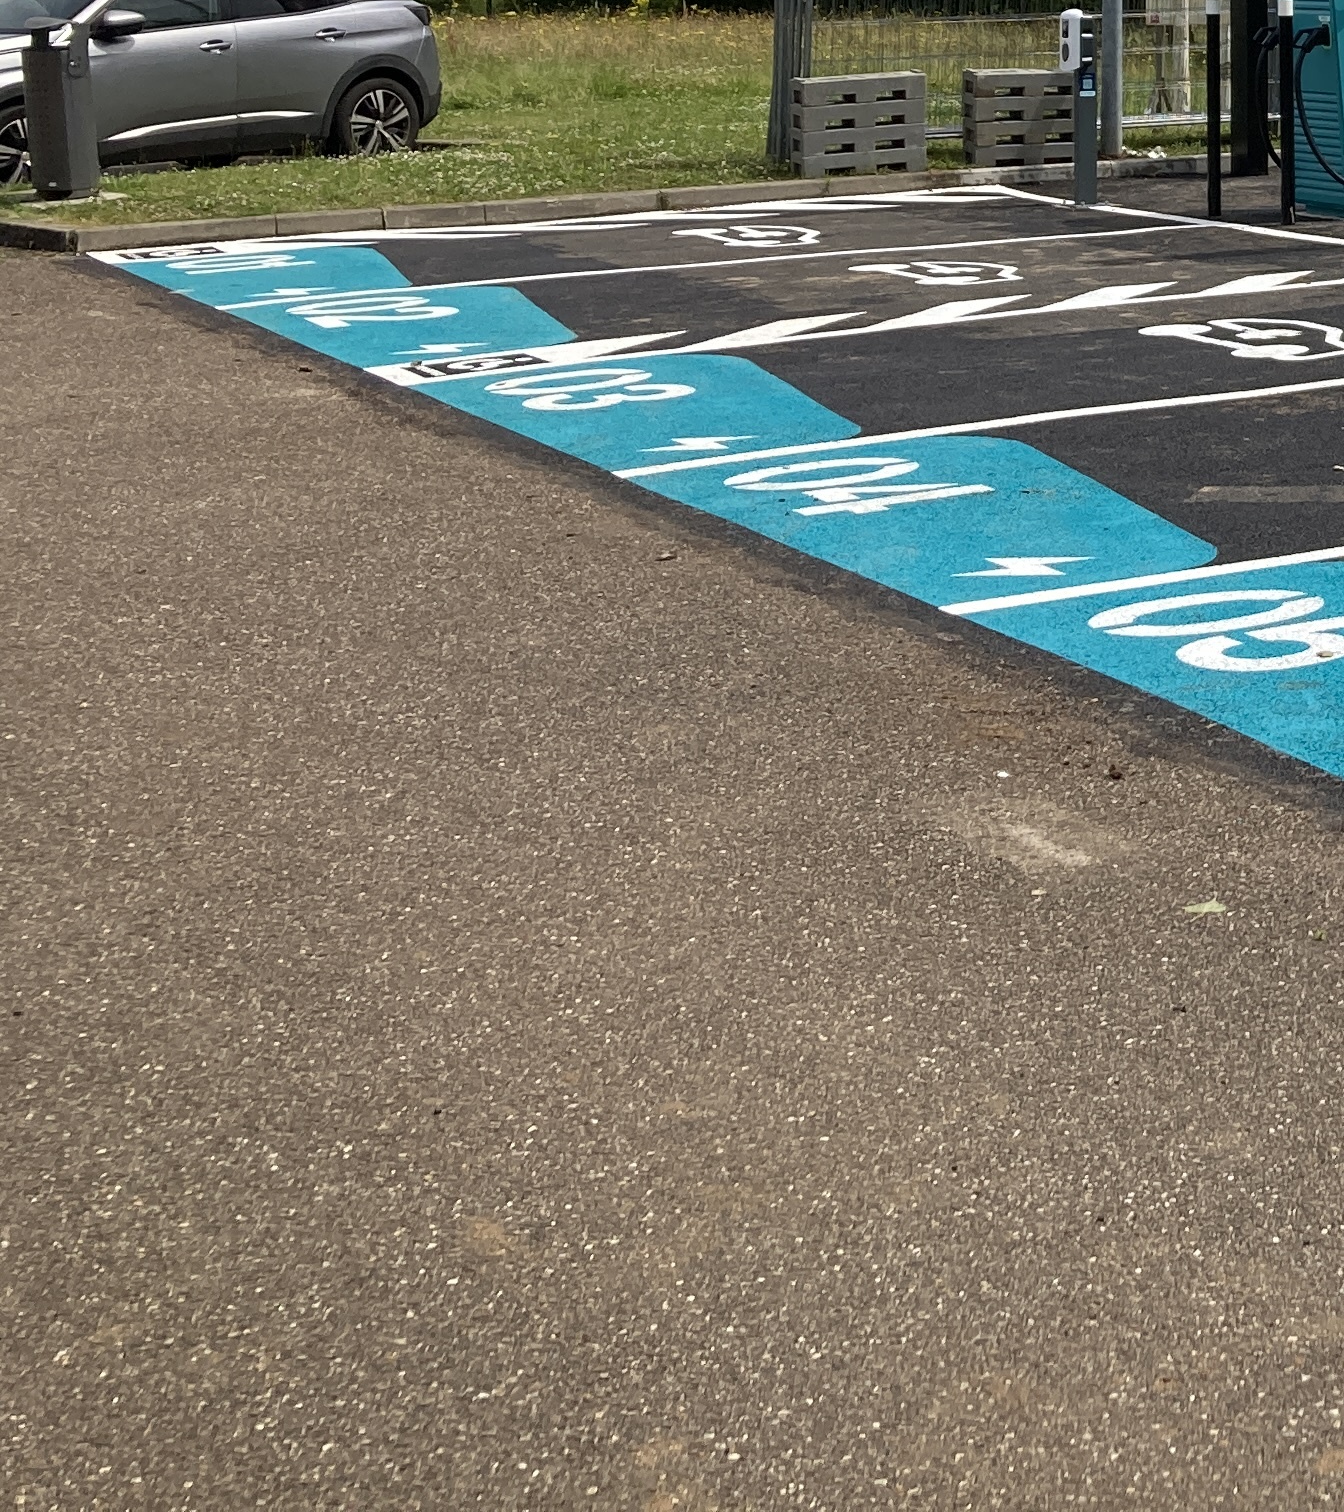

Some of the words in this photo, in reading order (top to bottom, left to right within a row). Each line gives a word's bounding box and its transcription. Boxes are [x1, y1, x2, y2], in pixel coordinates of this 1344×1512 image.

[166, 254, 316, 276] 01
[285, 296, 460, 329] 02
[484, 368, 696, 411] 03
[724, 457, 996, 517] 04
